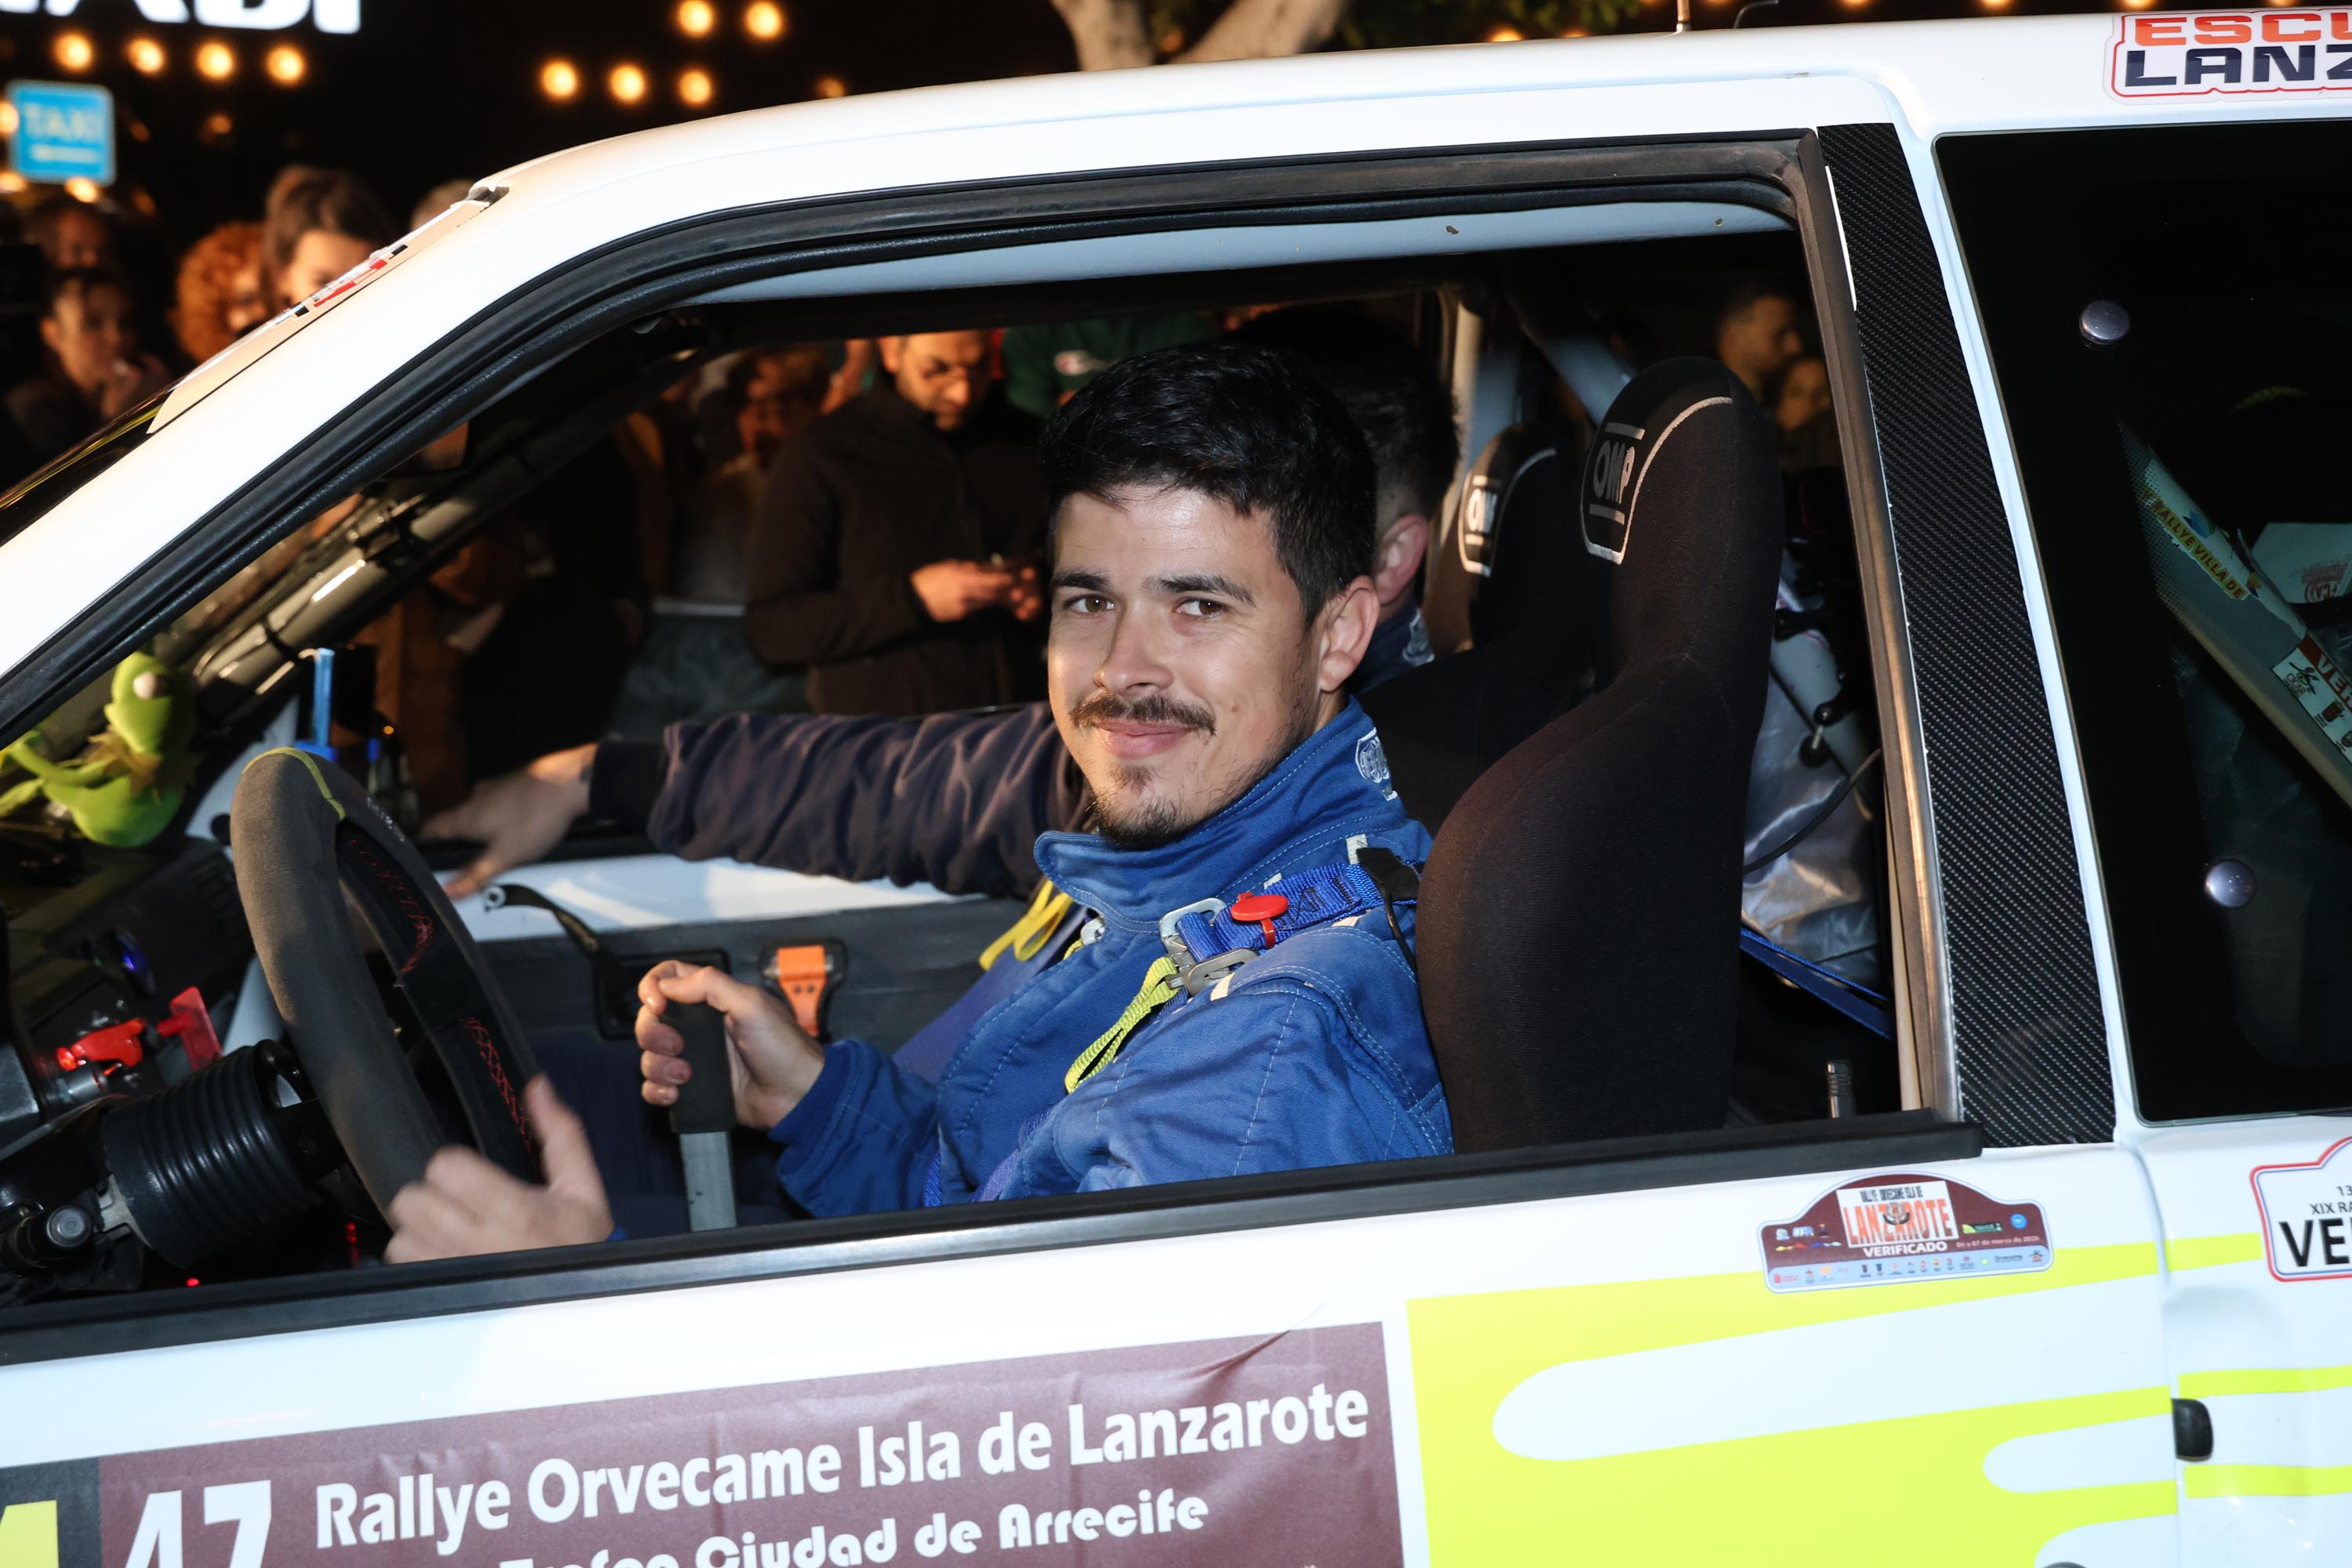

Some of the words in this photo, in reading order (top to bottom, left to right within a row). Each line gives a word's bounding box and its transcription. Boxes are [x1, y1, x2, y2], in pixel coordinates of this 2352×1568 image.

[1593, 440, 1636, 505] OMP
[2193, 544, 2227, 582] VILLA
[2225, 577, 2245, 598] DE
[2310, 1202, 2336, 1215] XIX
[1862, 1240, 1948, 1258] VERIFICADO
[2278, 1217, 2352, 1267] VE
[316, 1473, 509, 1556] Rallye
[527, 1443, 842, 1523] Orvecame
[858, 1421, 961, 1488] Isla
[978, 1410, 1052, 1476] de
[1068, 1383, 1368, 1466] Lanzarote
[695, 1517, 897, 1568] Ciudad
[914, 1512, 982, 1558] de
[998, 1487, 1209, 1550] Arrecife
